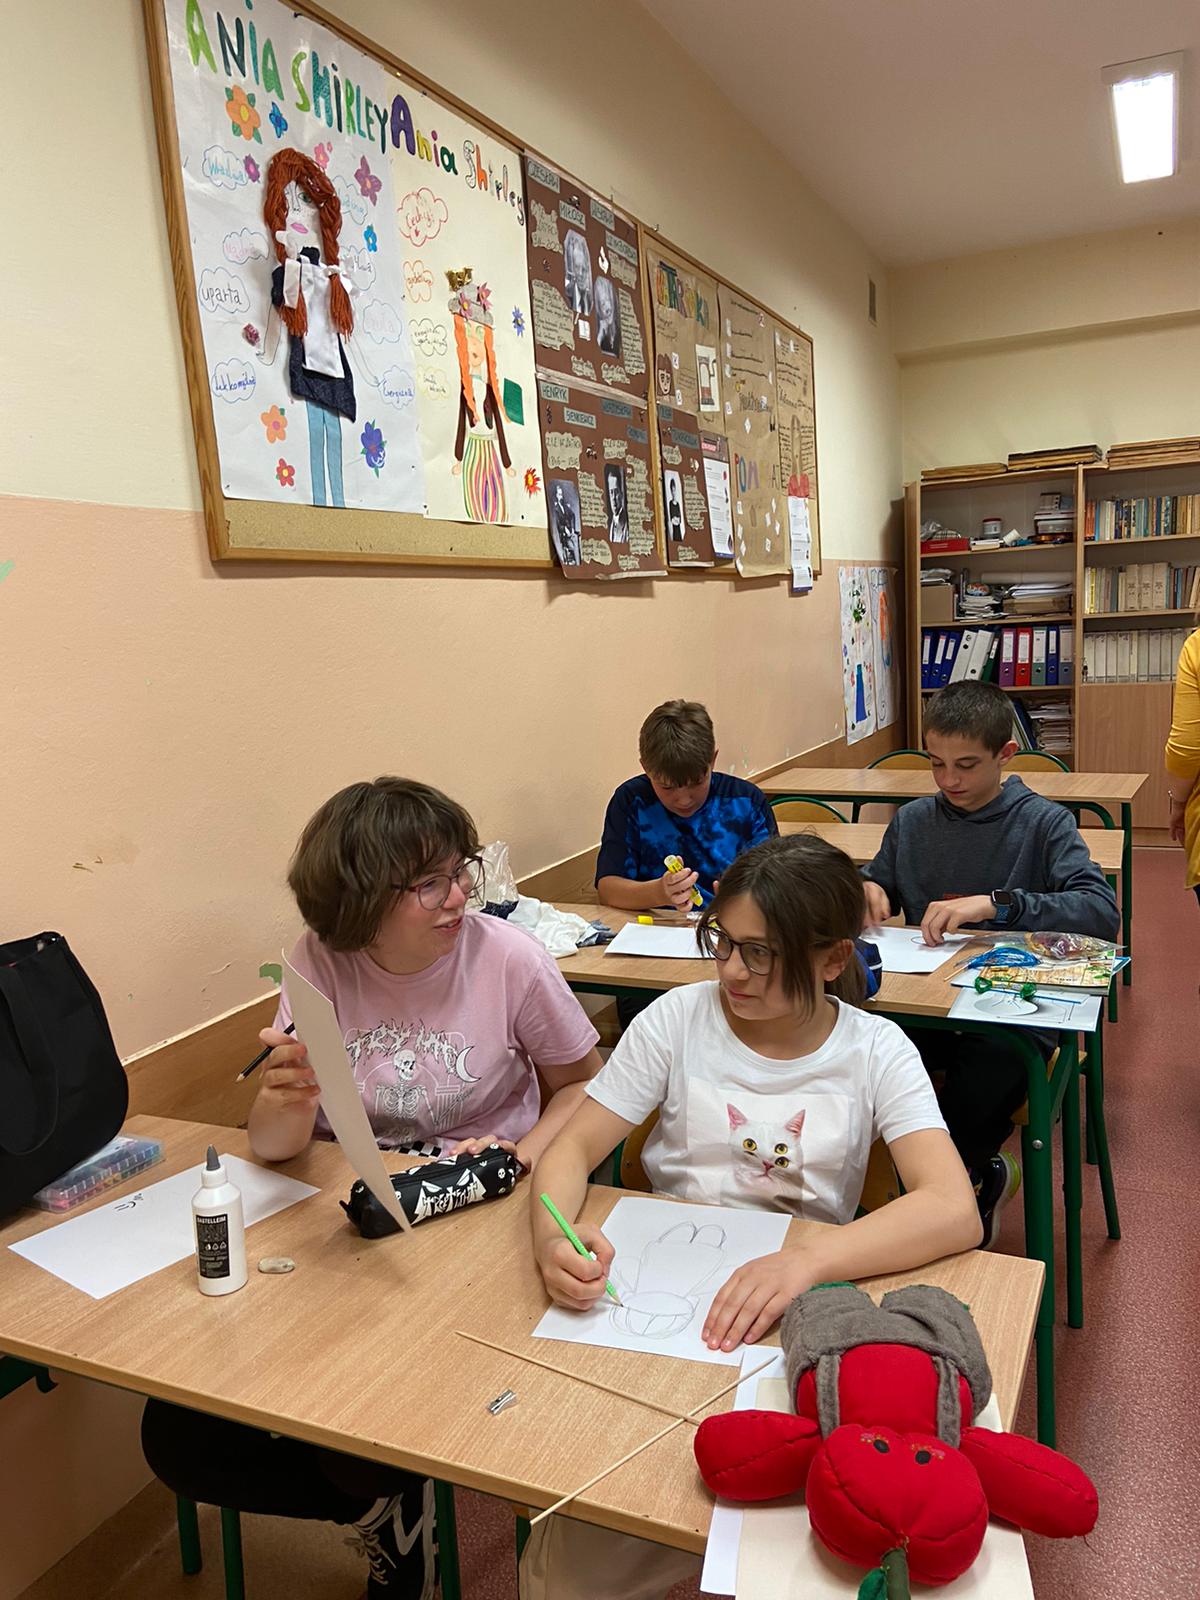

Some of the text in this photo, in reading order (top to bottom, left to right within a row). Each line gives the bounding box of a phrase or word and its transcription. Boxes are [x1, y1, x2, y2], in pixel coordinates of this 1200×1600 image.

[391, 95, 525, 226] Ania Shirley
[201, 282, 242, 307] uparta
